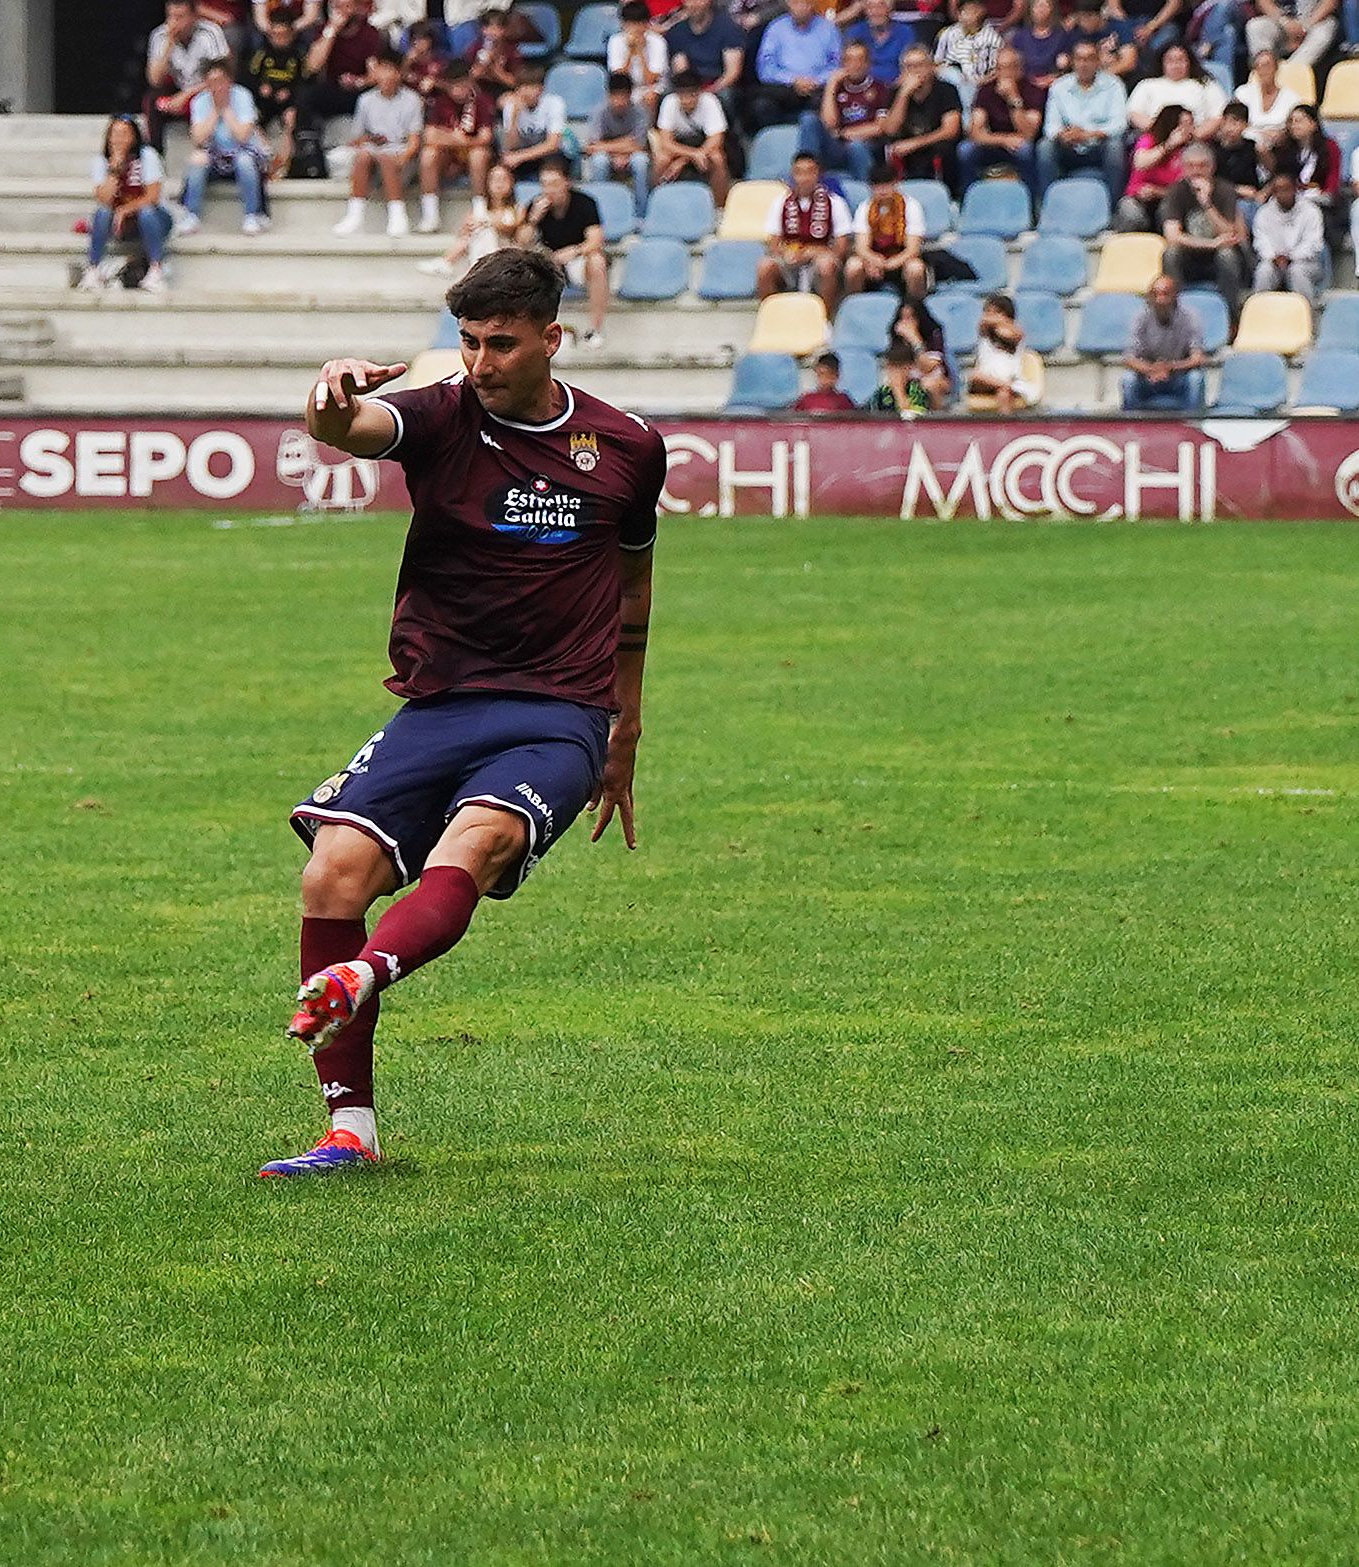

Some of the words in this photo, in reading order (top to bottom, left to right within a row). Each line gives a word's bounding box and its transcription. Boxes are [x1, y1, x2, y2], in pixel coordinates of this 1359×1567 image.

[19, 429, 256, 499] SEPO
[503, 488, 582, 510] Estrella
[504, 507, 576, 528] Galicia
